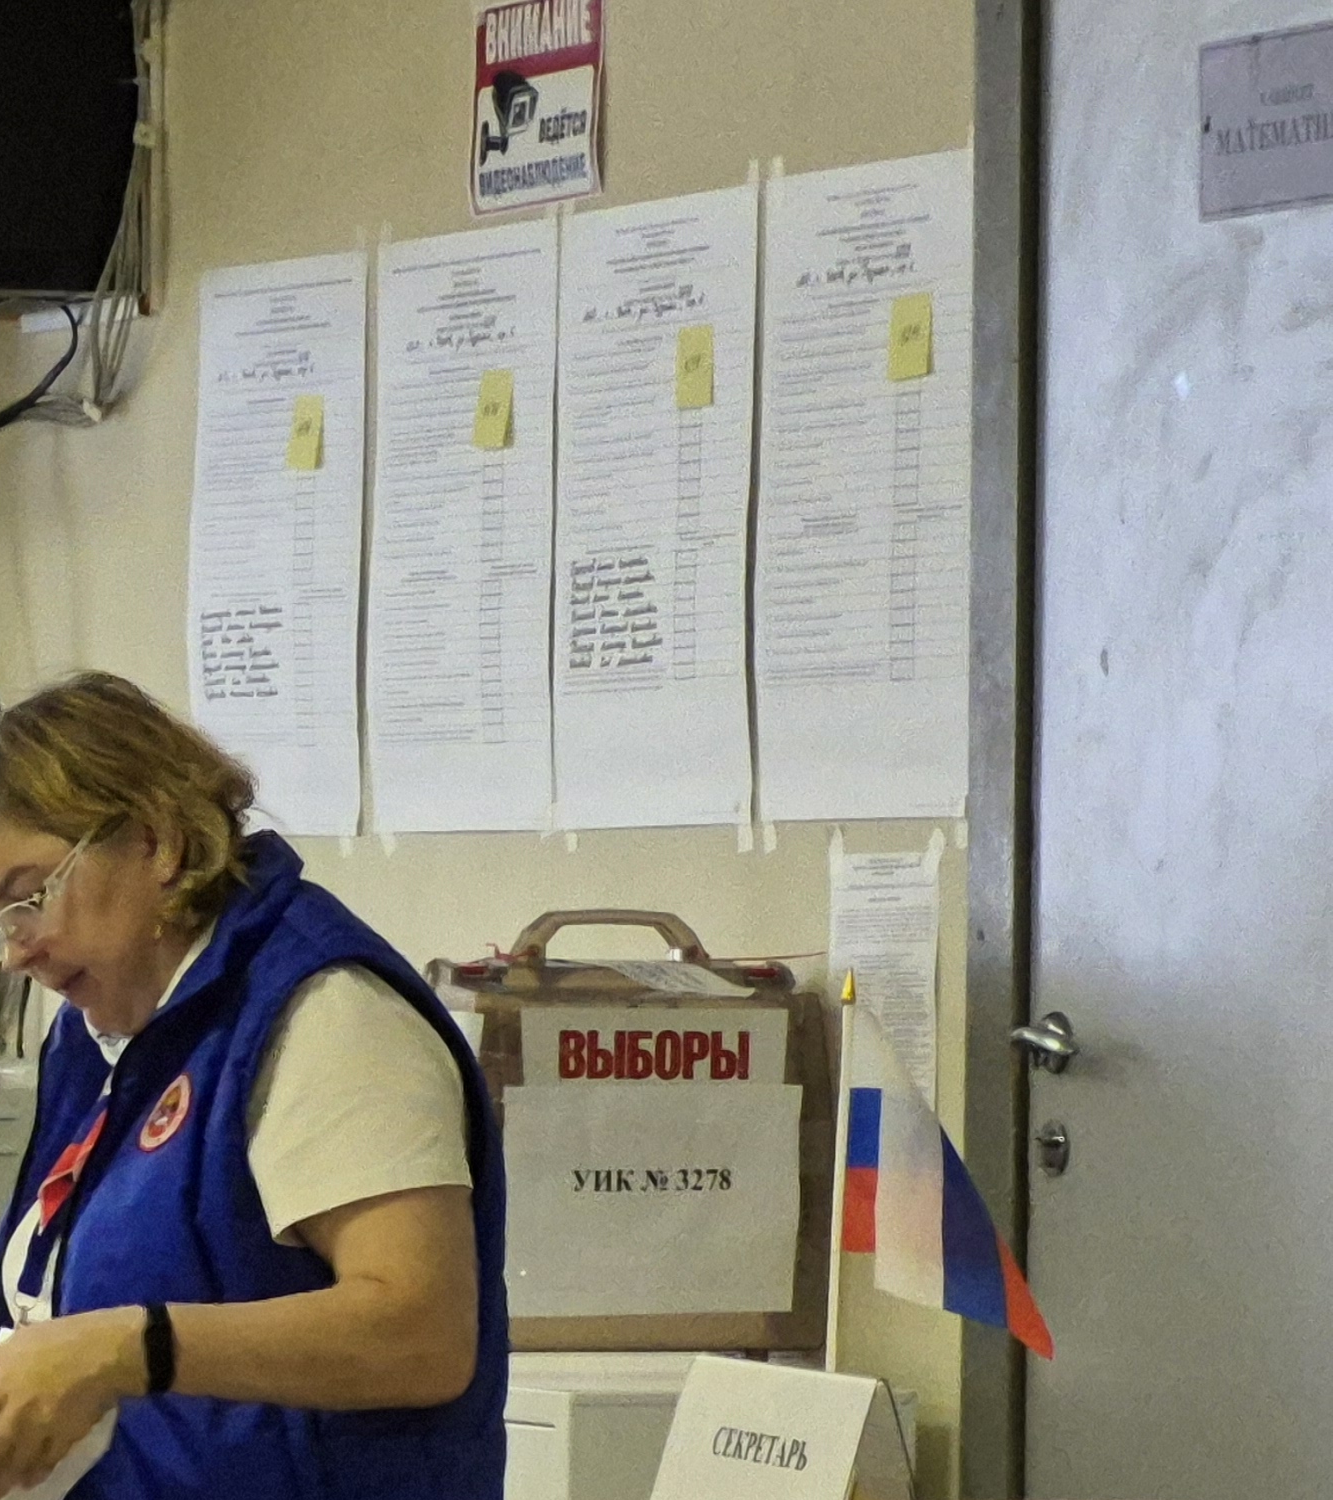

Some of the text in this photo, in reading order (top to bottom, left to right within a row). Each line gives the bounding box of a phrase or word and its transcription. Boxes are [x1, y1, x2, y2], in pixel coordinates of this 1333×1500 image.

[486, 0, 592, 65] ВНИМАНИЕ
[1216, 112, 1333, 155] МАТЕМАТИ
[479, 153, 587, 196] ВИДЕОНАБЛЮДЕНИЕ
[559, 1029, 750, 1080] ВЫБОРЫ
[573, 1168, 732, 1192] УИК № 3278
[713, 1426, 808, 1471] СЕКРЕТАРЬ
